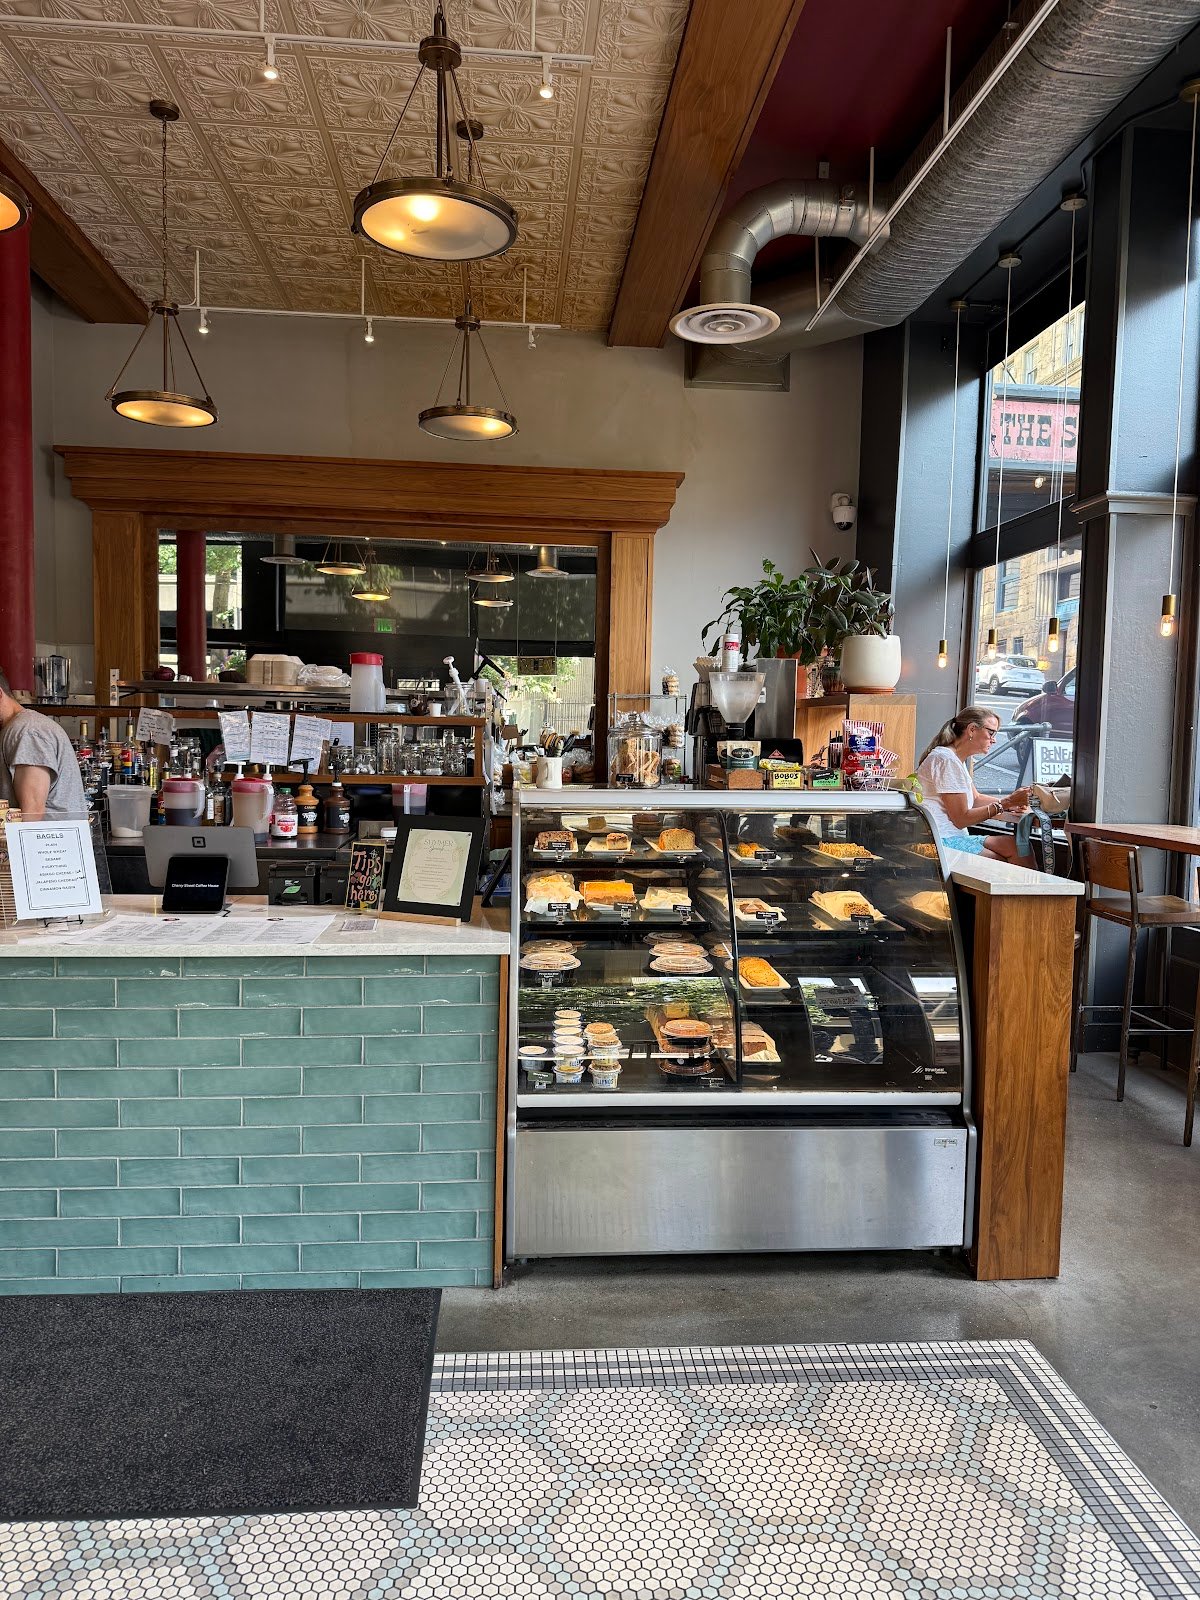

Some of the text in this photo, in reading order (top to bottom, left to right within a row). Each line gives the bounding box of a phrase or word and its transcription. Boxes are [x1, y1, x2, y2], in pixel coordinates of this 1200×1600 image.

[1000, 413, 1052, 448] THE
[848, 753, 876, 761] Original
[36, 832, 64, 840] BAGELS
[353, 850, 382, 877] Tips
[356, 874, 372, 890] go
[350, 884, 377, 904] here
